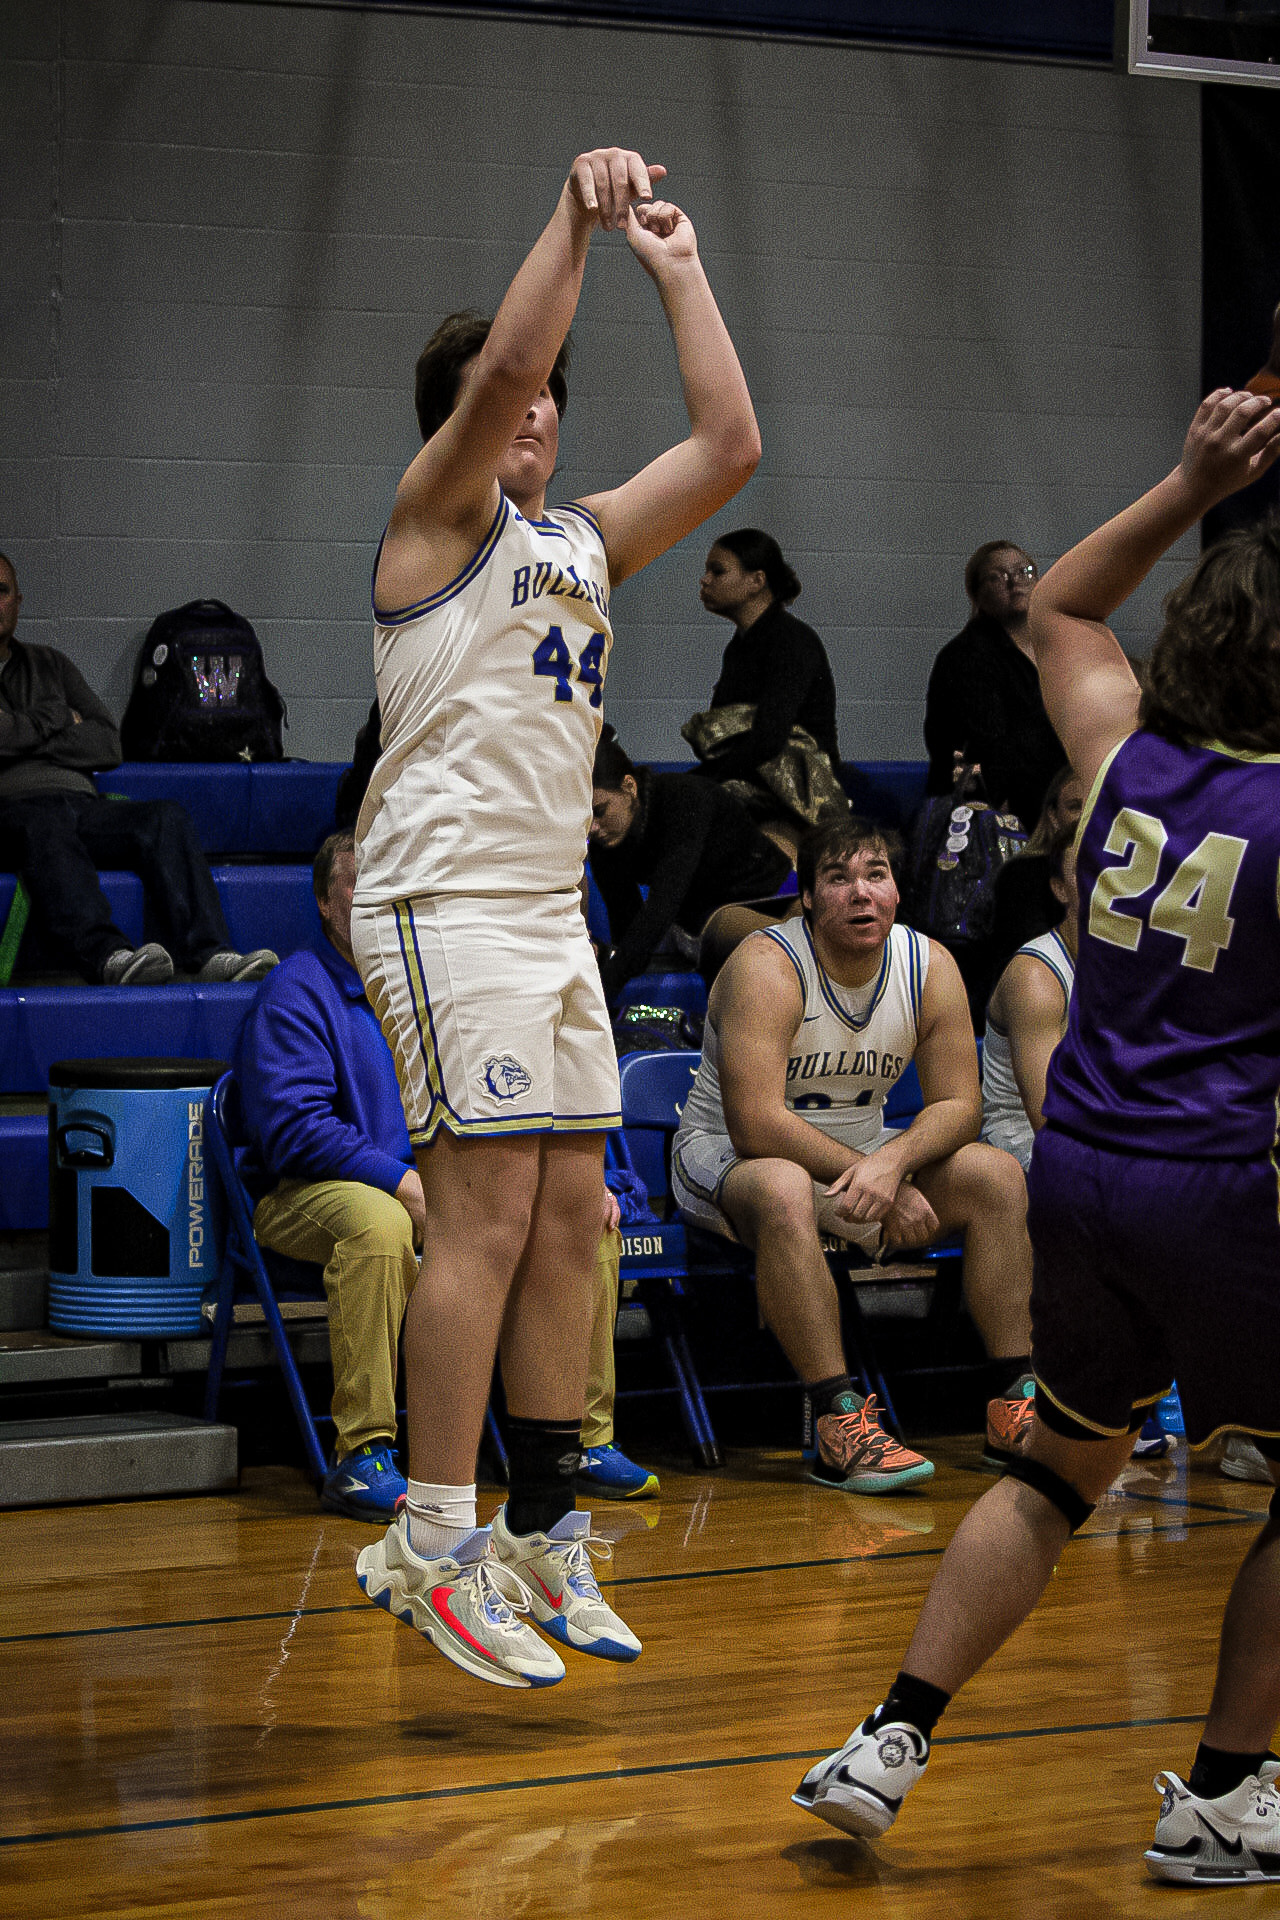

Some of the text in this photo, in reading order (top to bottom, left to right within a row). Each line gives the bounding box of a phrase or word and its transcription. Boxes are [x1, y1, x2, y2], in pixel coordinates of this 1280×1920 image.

[531, 624, 606, 708] 44
[1088, 807, 1249, 973] 24
[786, 1049, 904, 1082] BULLDOGS
[188, 1102, 204, 1268] POWERADE
